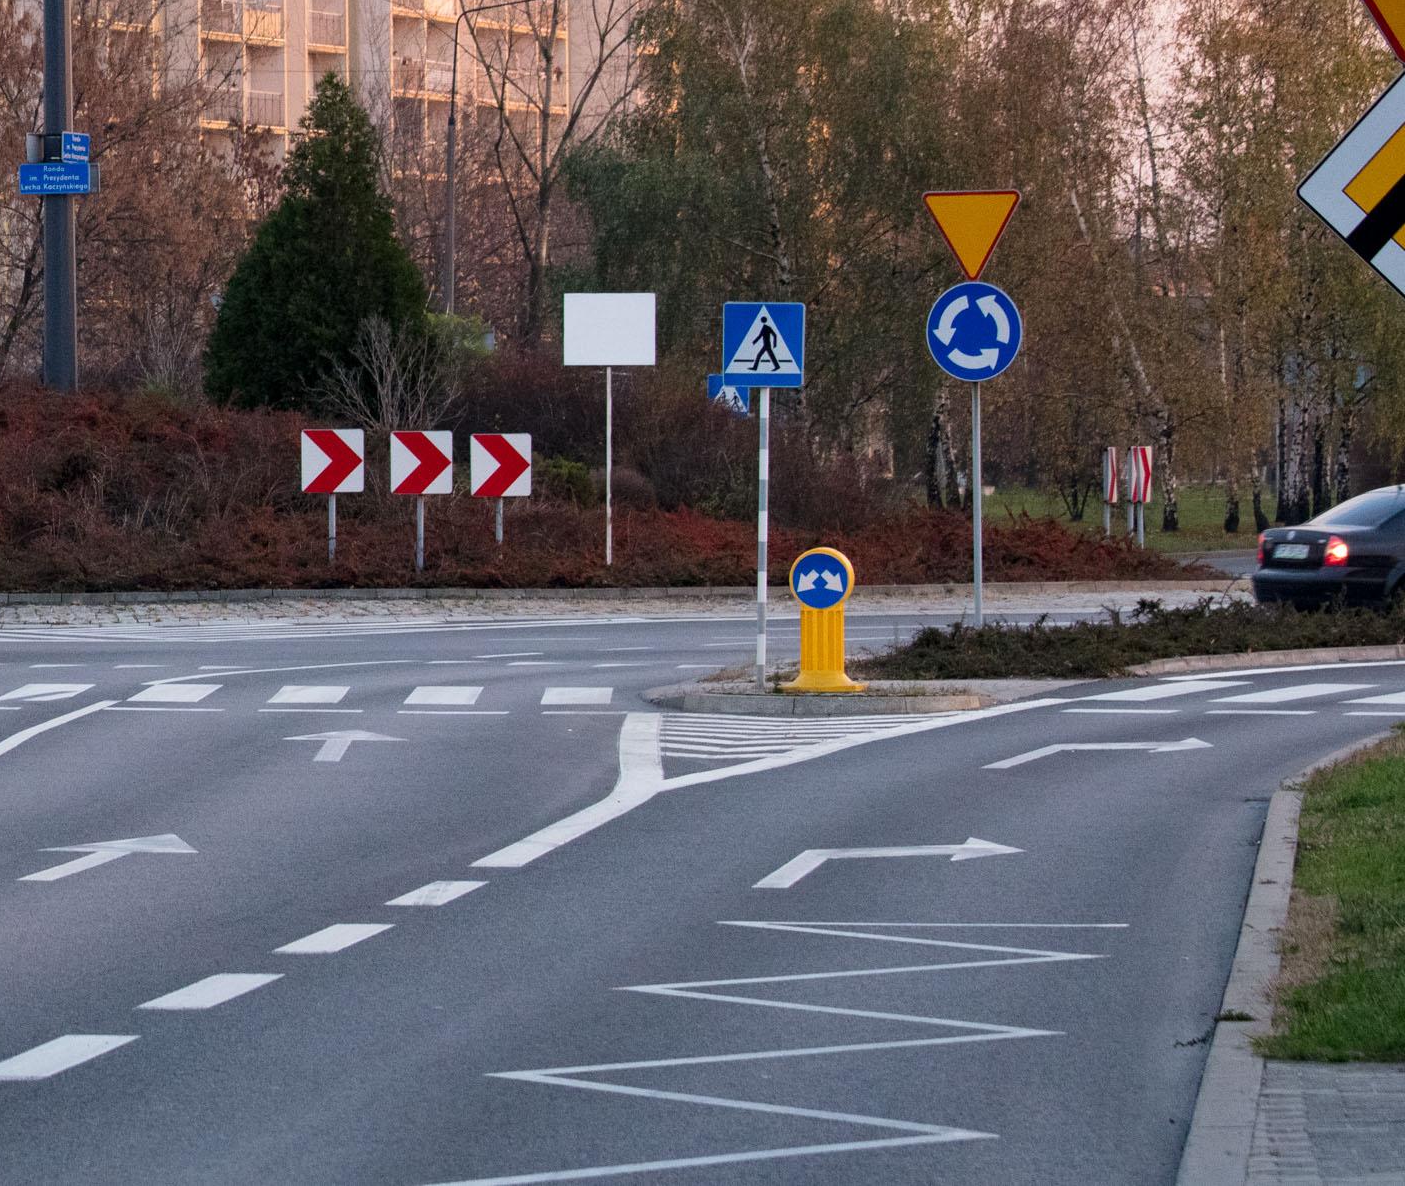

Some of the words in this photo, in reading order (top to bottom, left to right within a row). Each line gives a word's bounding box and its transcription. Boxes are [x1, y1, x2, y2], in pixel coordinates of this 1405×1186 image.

[43, 174, 80, 183] Prezydenta
[20, 183, 41, 191] Lecha
[43, 183, 88, 192] Kaczyńskiego
